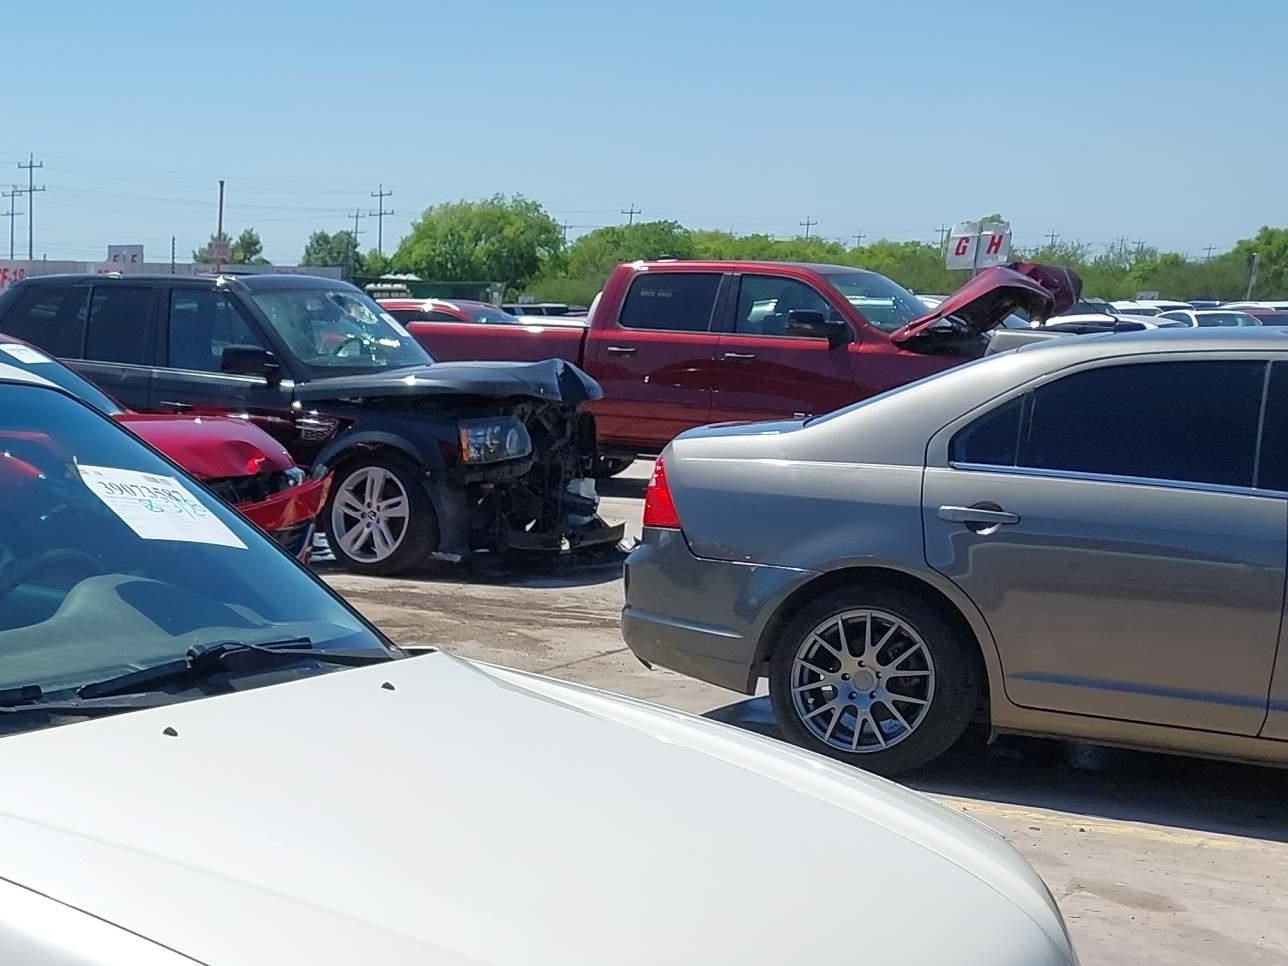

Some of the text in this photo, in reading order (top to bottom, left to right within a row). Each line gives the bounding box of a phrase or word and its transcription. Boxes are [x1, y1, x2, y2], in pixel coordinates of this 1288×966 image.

[955, 237, 969, 255] G
[986, 235, 1003, 254] H
[97, 481, 185, 502] 39073587
